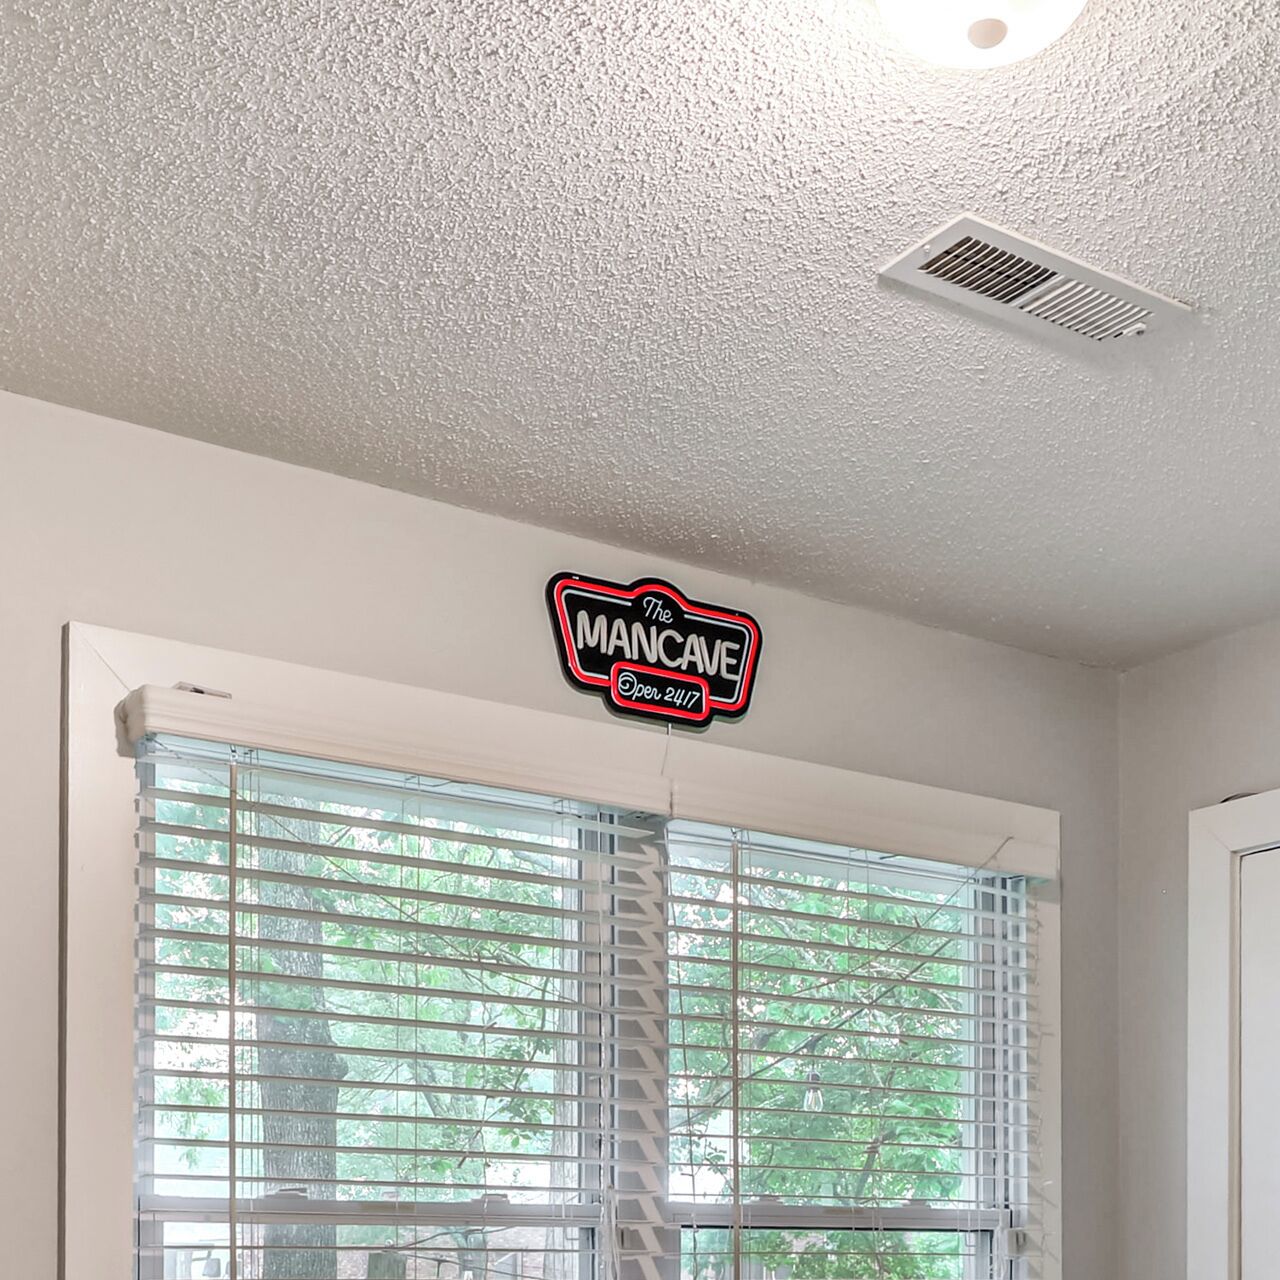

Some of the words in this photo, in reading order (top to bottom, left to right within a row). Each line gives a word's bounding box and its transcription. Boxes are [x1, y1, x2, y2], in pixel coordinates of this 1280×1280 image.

[643, 596, 673, 623] The
[576, 610, 741, 681] MANCAVE
[618, 671, 662, 701] Open
[663, 686, 701, 709] 24/7
